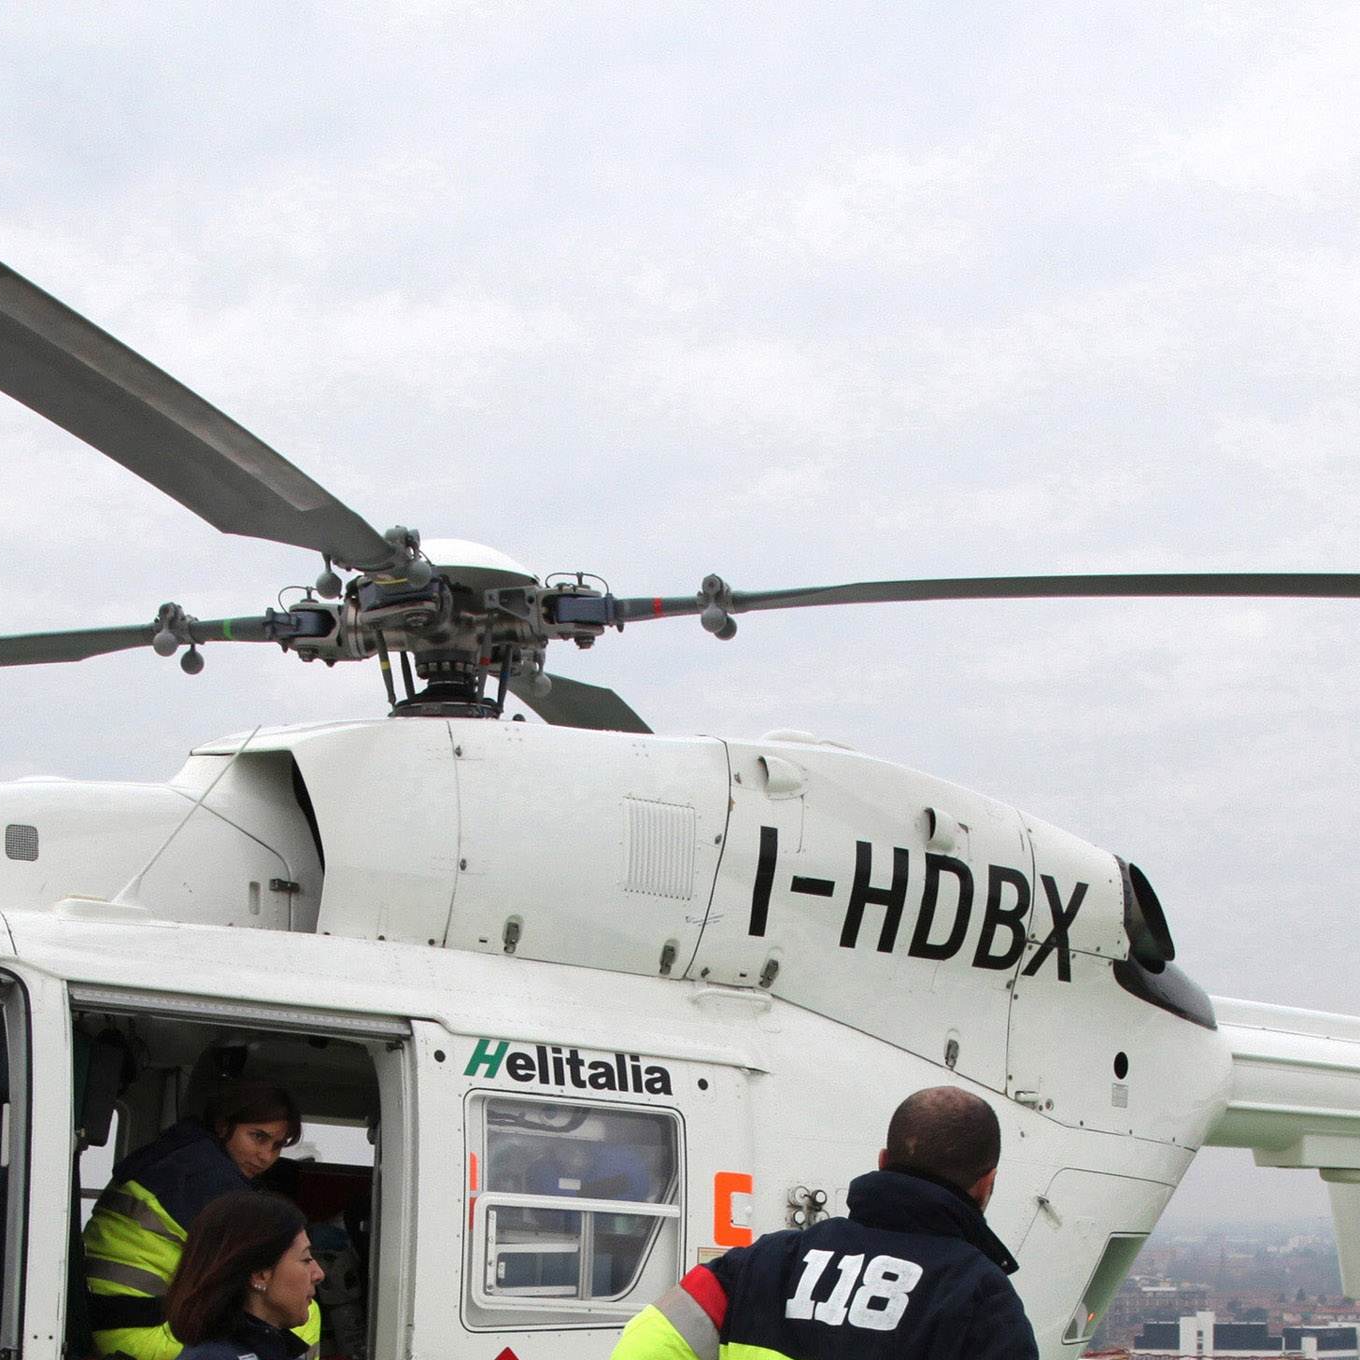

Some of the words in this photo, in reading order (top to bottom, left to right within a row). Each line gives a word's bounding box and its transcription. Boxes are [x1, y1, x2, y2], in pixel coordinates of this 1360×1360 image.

[748, 826, 1089, 982] I-HDBX
[463, 1038, 673, 1096] Helitalia
[785, 1249, 923, 1331] 118
